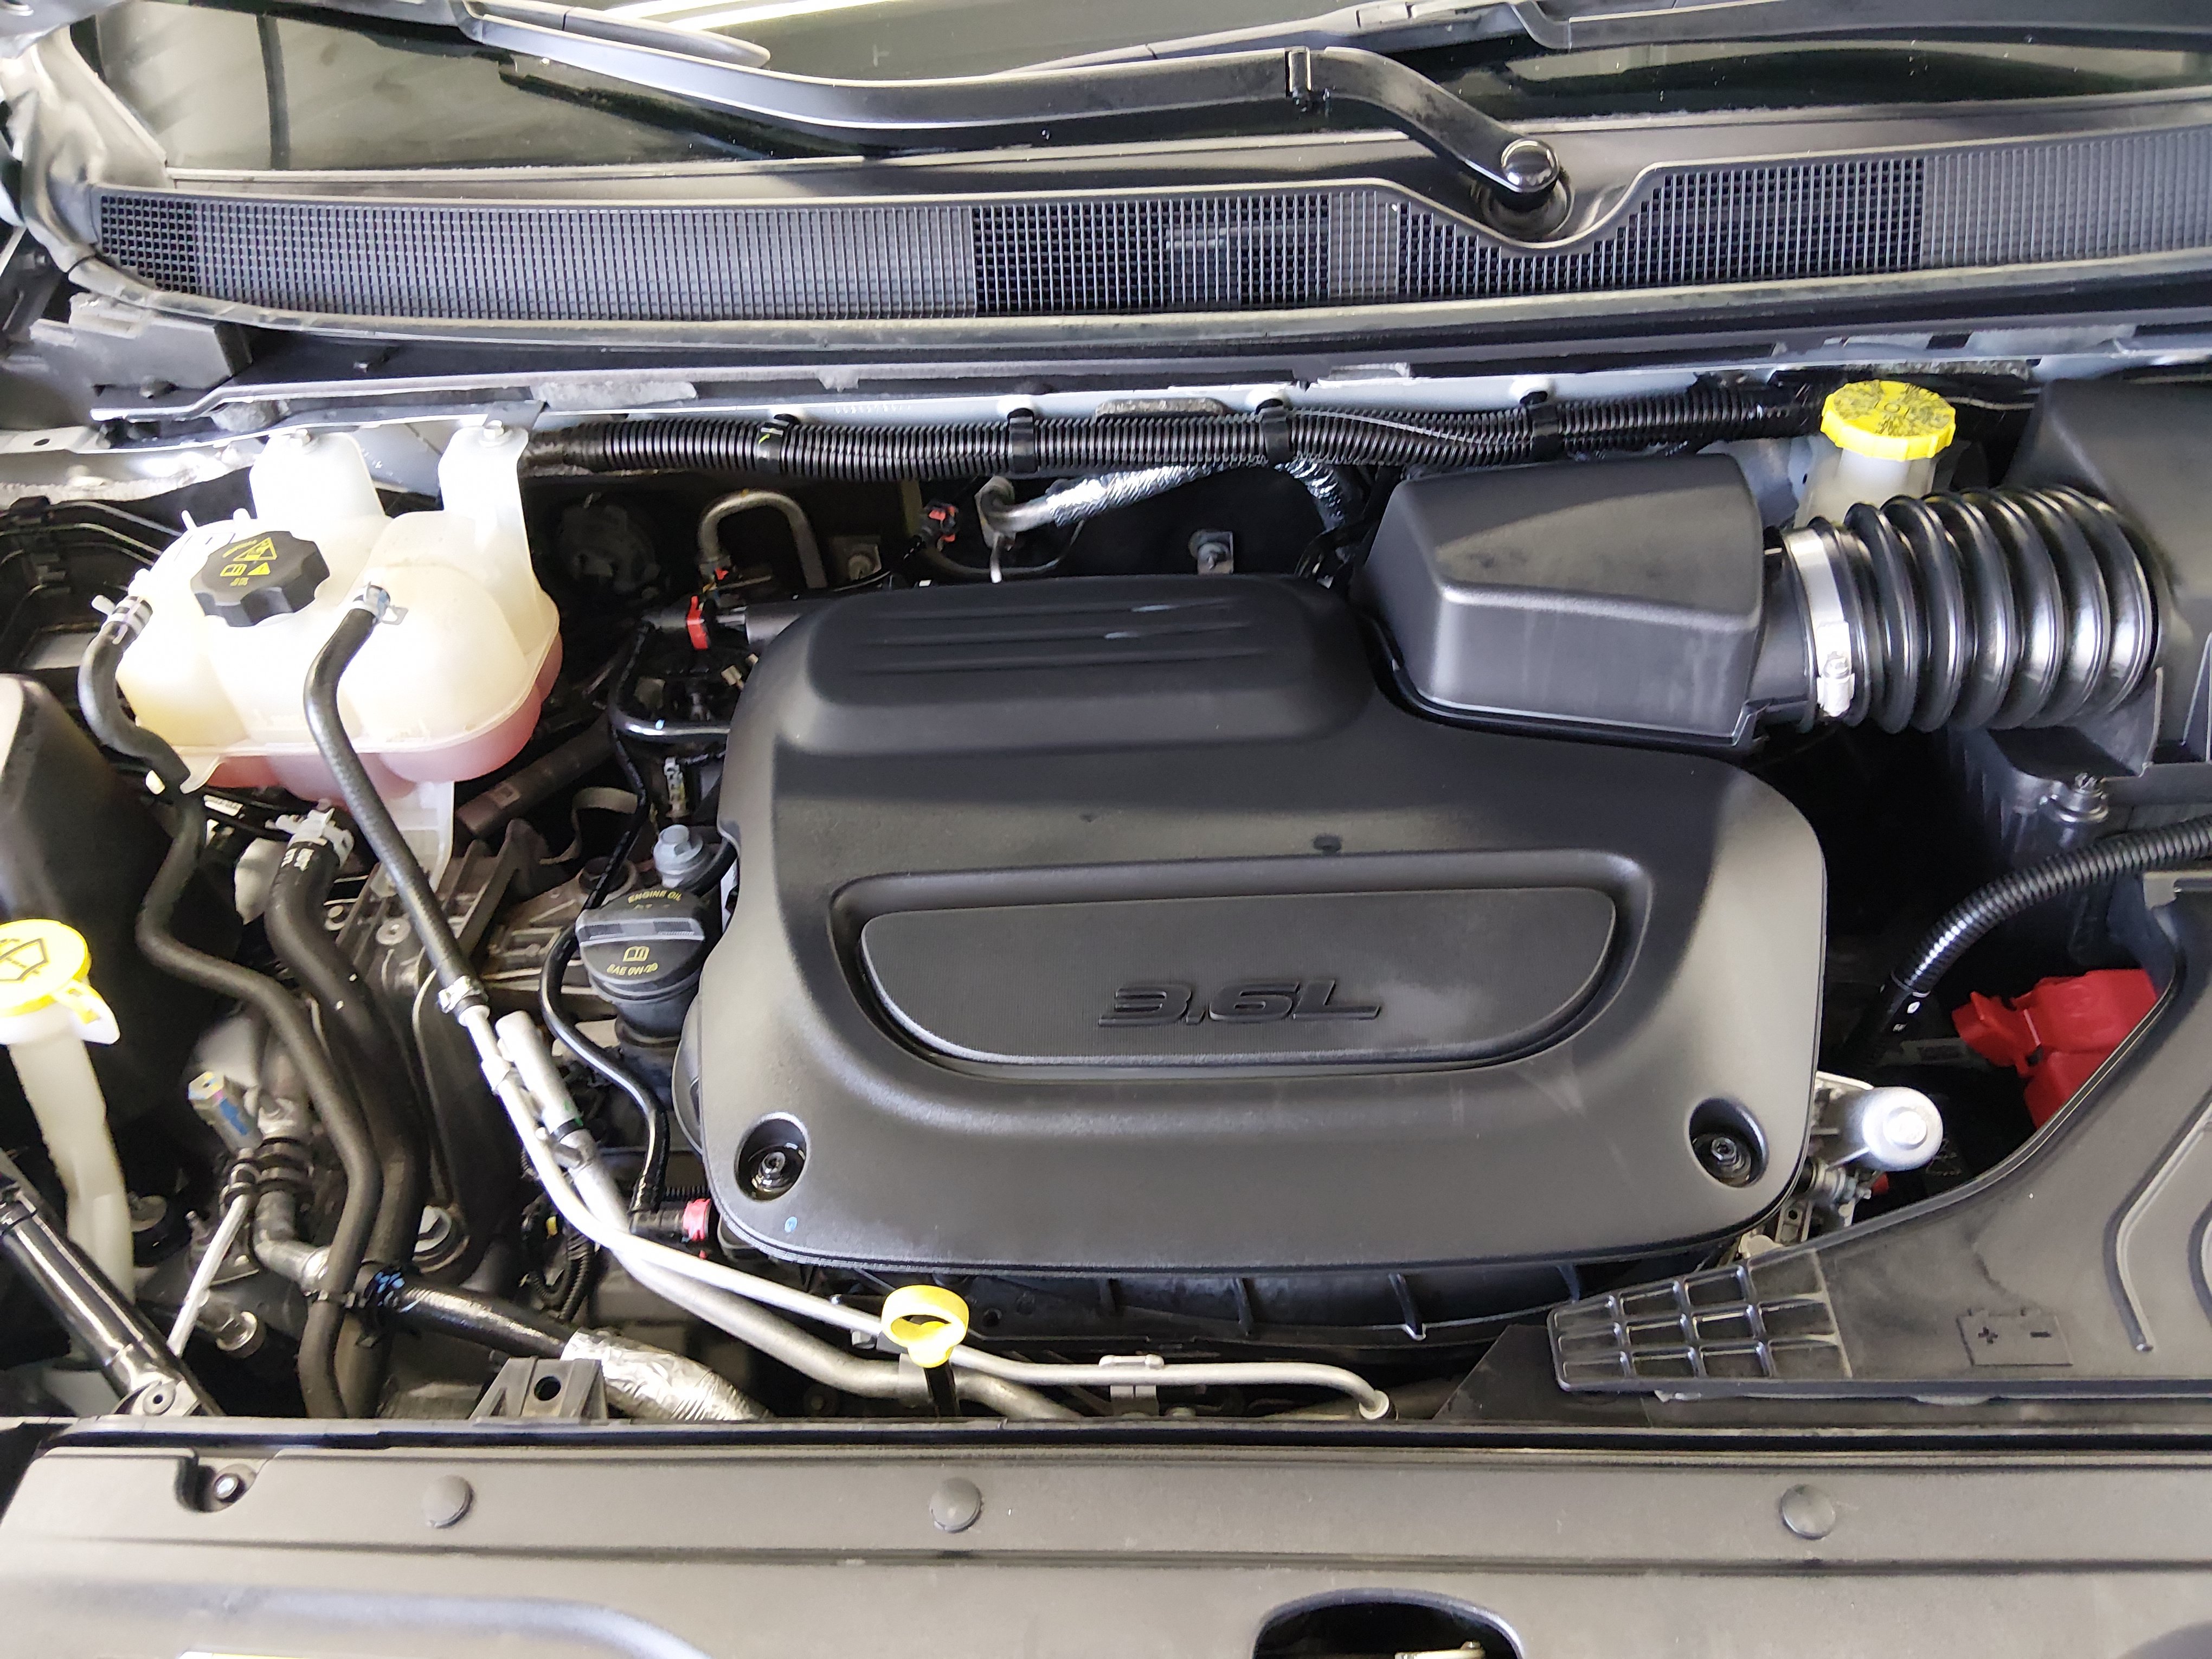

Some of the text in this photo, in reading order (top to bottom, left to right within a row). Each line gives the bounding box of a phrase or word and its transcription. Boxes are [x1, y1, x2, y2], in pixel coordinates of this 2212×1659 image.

[628, 890, 681, 903] ENGINE OIL
[1098, 979, 1381, 1027] 3.6L
